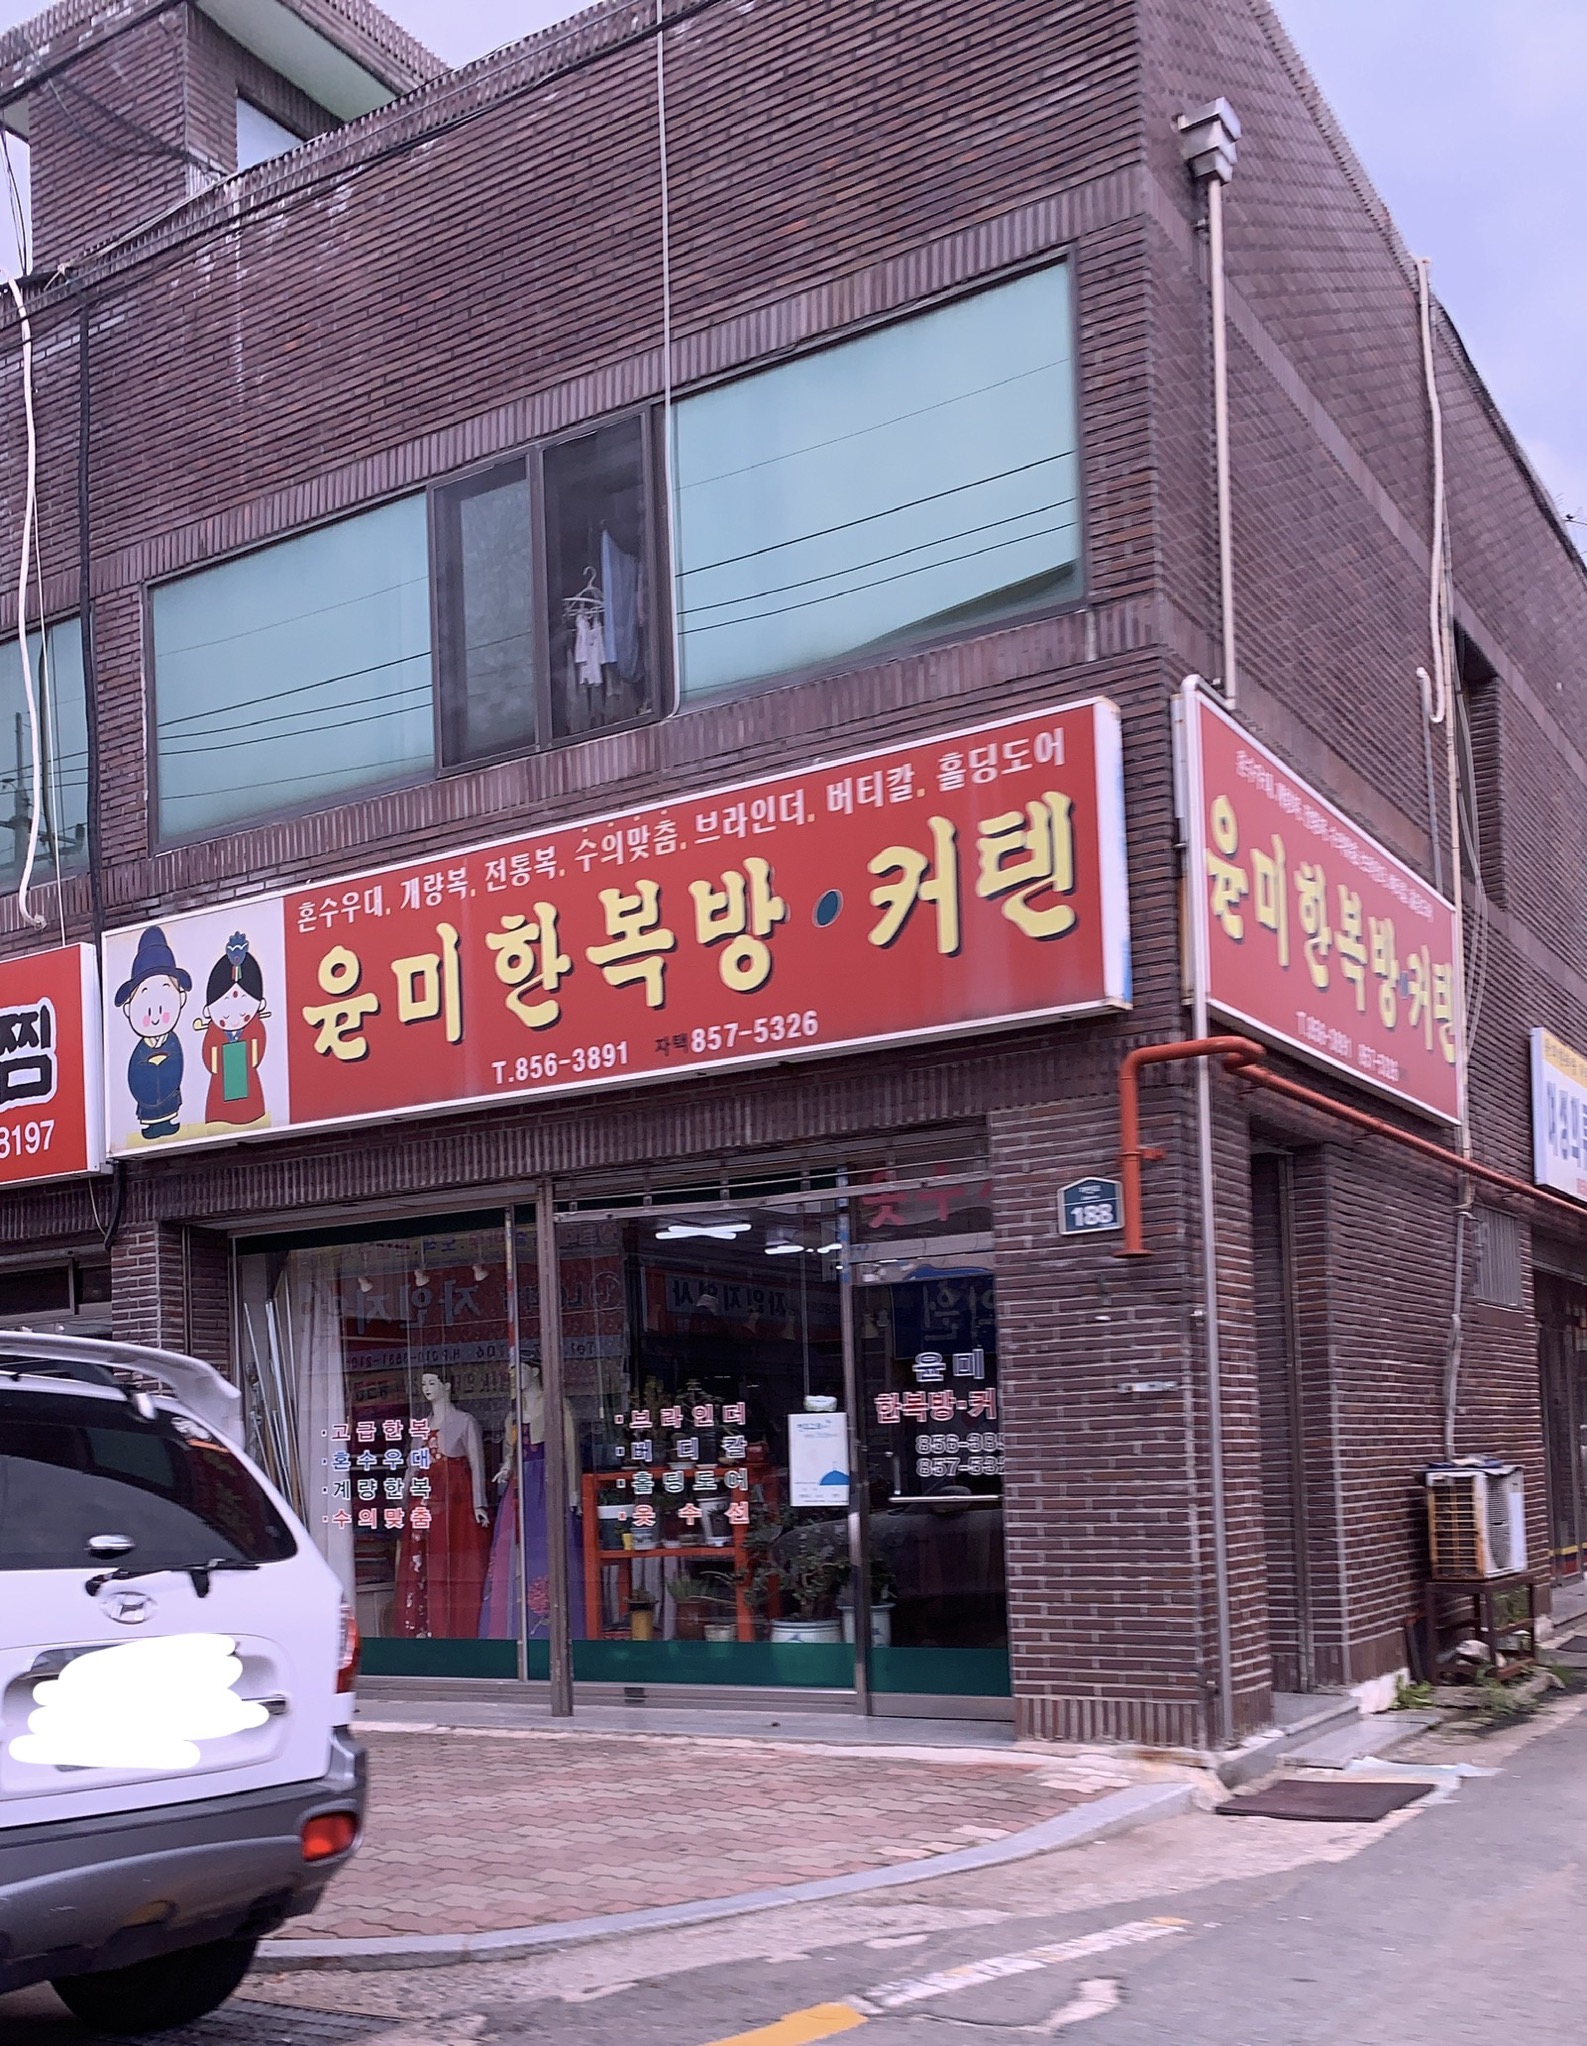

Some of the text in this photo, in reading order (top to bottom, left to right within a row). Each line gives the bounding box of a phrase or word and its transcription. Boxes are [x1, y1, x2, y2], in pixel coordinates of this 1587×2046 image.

[937, 727, 1066, 792] 홀딩도어
[491, 1010, 819, 1085] T.856-3891 자택 857-5326
[1070, 1203, 1114, 1227] 188
